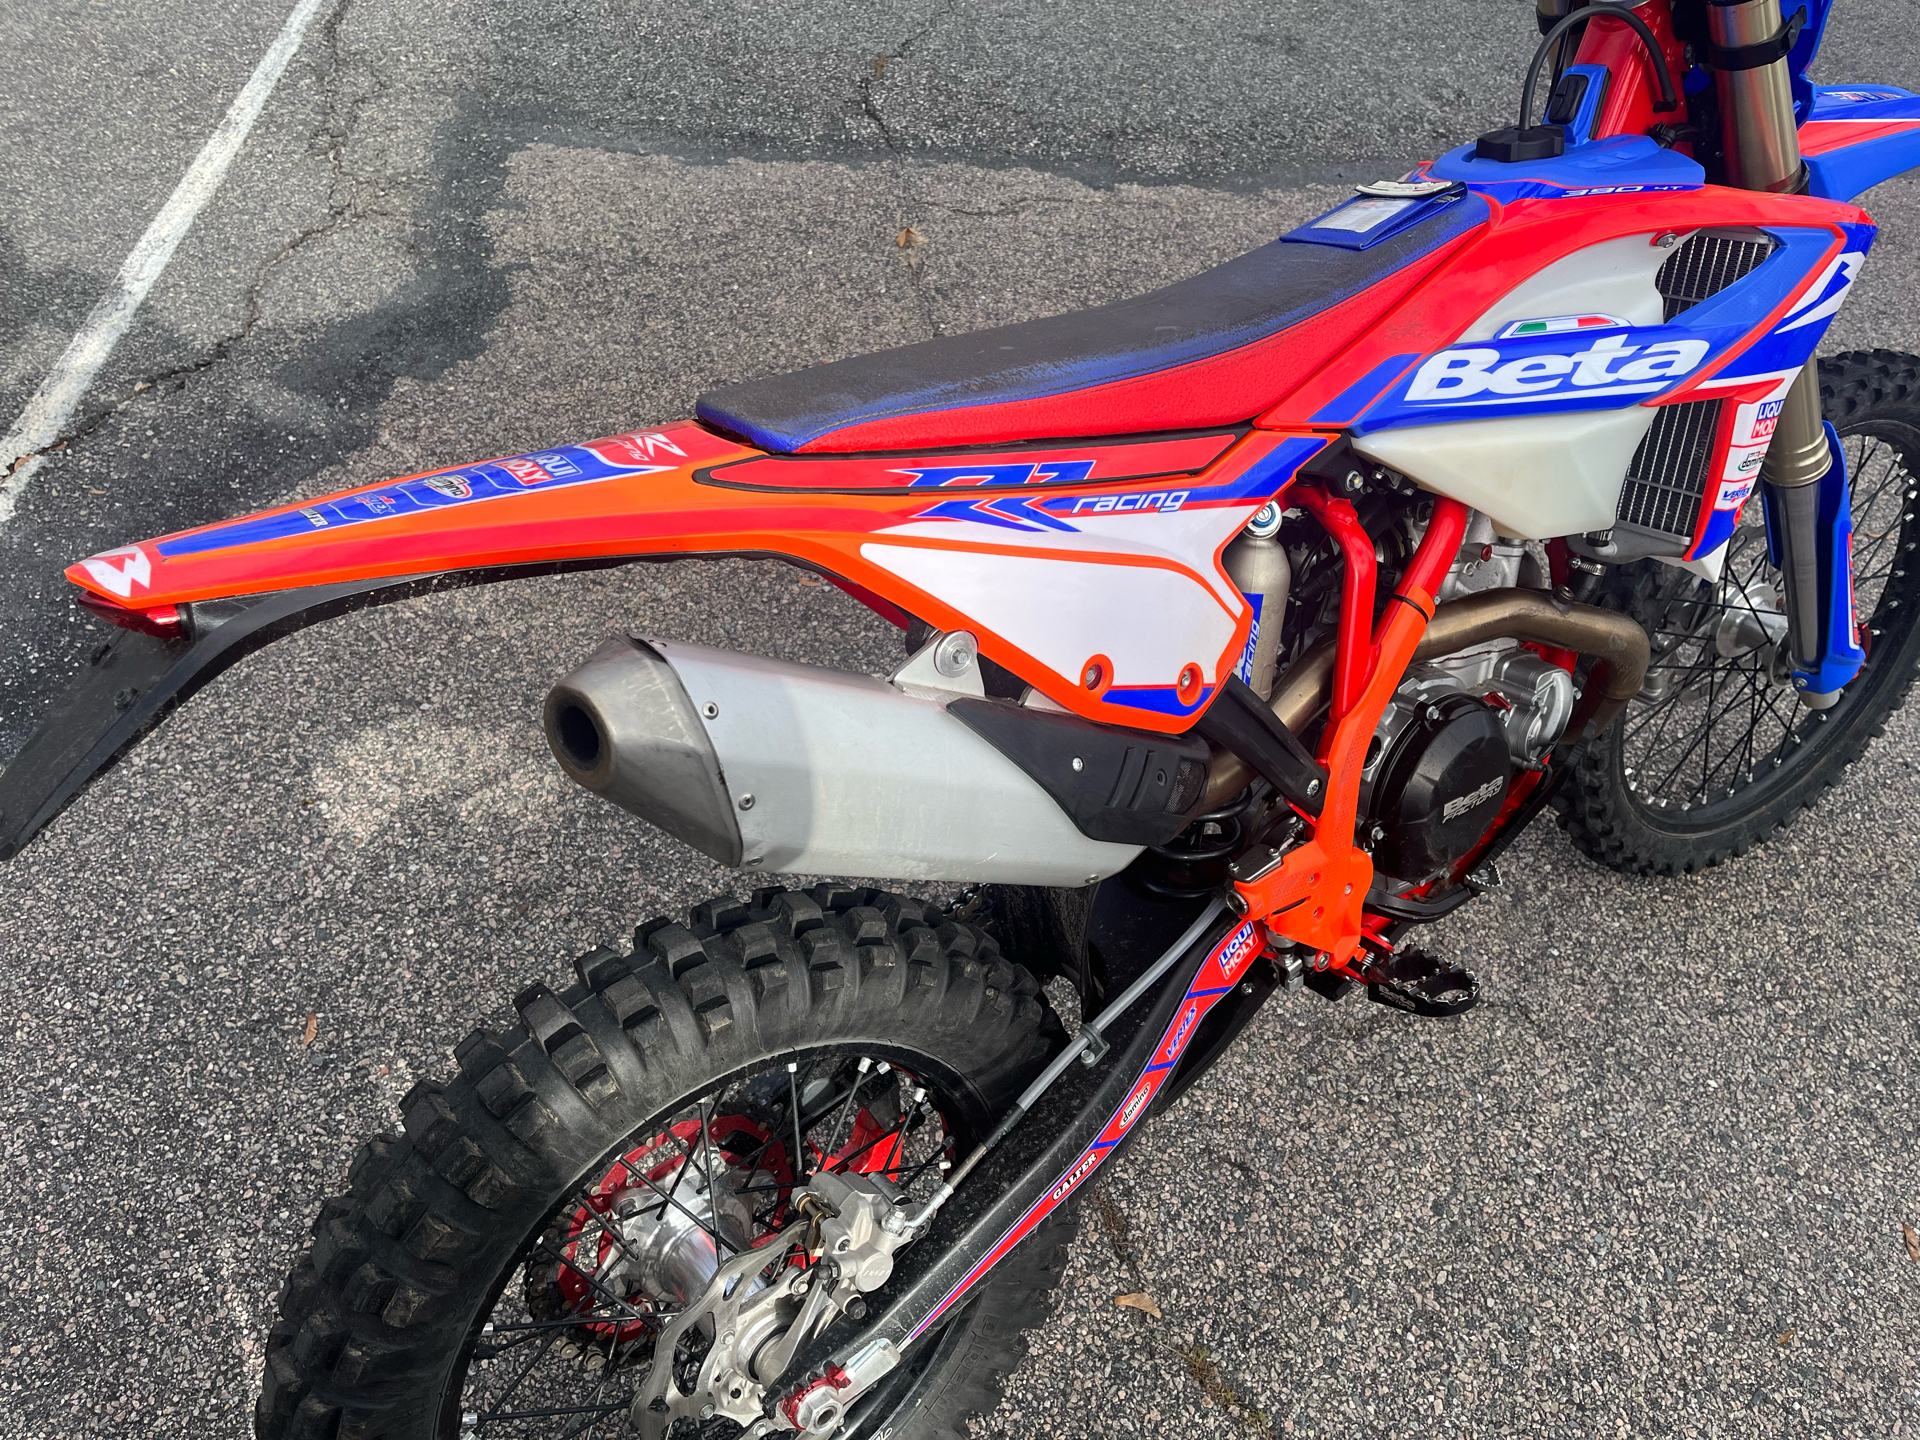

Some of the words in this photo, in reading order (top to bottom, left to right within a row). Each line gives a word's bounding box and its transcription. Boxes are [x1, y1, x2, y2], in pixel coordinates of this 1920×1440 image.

[1403, 334, 1710, 401] Beta
[1757, 400, 1784, 420] LIQU
[1070, 491, 1191, 515] racing
[1443, 775, 1504, 817] Beta
[1220, 923, 1253, 966] LIQUI
[1224, 934, 1254, 976] MOLY
[1122, 1086, 1149, 1123] domino
[1052, 1151, 1098, 1201] GALFER
